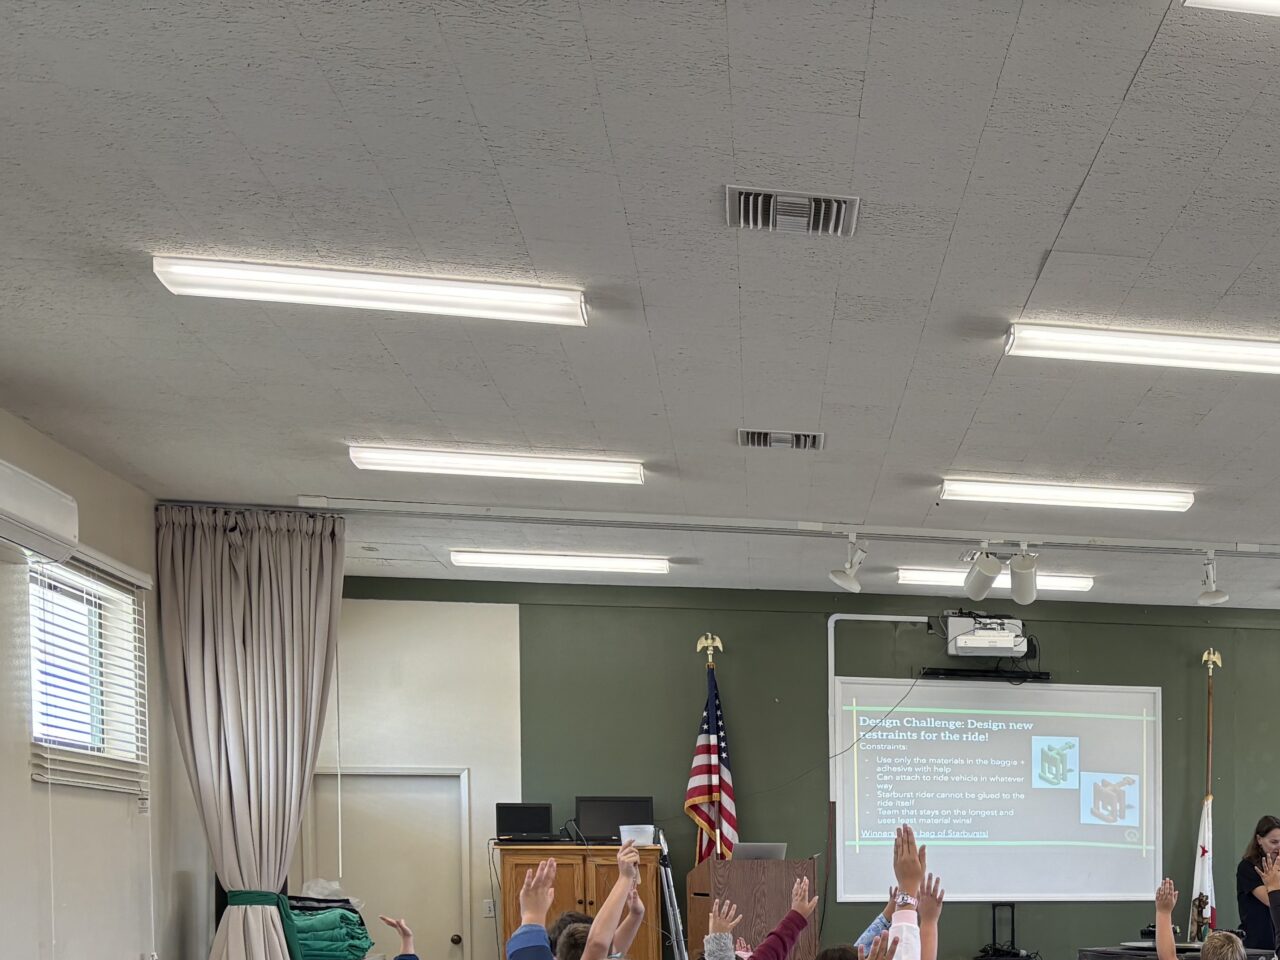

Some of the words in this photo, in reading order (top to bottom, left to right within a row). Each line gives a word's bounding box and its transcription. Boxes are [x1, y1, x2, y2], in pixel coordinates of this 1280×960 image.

[859, 716, 900, 728] Design
[903, 717, 965, 730] Challenge:
[967, 719, 1006, 731] Design
[1008, 721, 1034, 730] new
[859, 730, 918, 740] restraints
[920, 730, 938, 740] for
[941, 731, 960, 741] the
[962, 732, 989, 742] ride!
[860, 742, 908, 751] Constraints:
[876, 755, 892, 763] Use
[894, 756, 912, 766] only
[913, 756, 927, 764] the
[929, 757, 965, 765] materials
[966, 757, 974, 765] in
[990, 758, 1018, 767] baggie
[876, 764, 913, 773] adhesive
[914, 765, 932, 773] with
[933, 765, 952, 774] help
[876, 773, 894, 781] Can
[895, 773, 921, 781] attach
[933, 773, 949, 781] ride
[951, 774, 978, 782] vehicle
[989, 775, 1025, 783] whatever
[876, 783, 893, 791] way
[877, 790, 914, 798] Starburst
[915, 790, 935, 798] rider
[936, 791, 964, 799] cannot
[965, 791, 976, 799] be
[977, 792, 1001, 801] glued
[877, 799, 894, 807] ride
[895, 799, 915, 807] itself
[878, 807, 900, 816] Team
[901, 808, 918, 816] that
[919, 808, 939, 817] stays
[953, 808, 967, 816] the
[968, 808, 998, 818] longest
[999, 808, 1015, 816] and
[877, 817, 896, 825] uses
[918, 817, 951, 825] material
